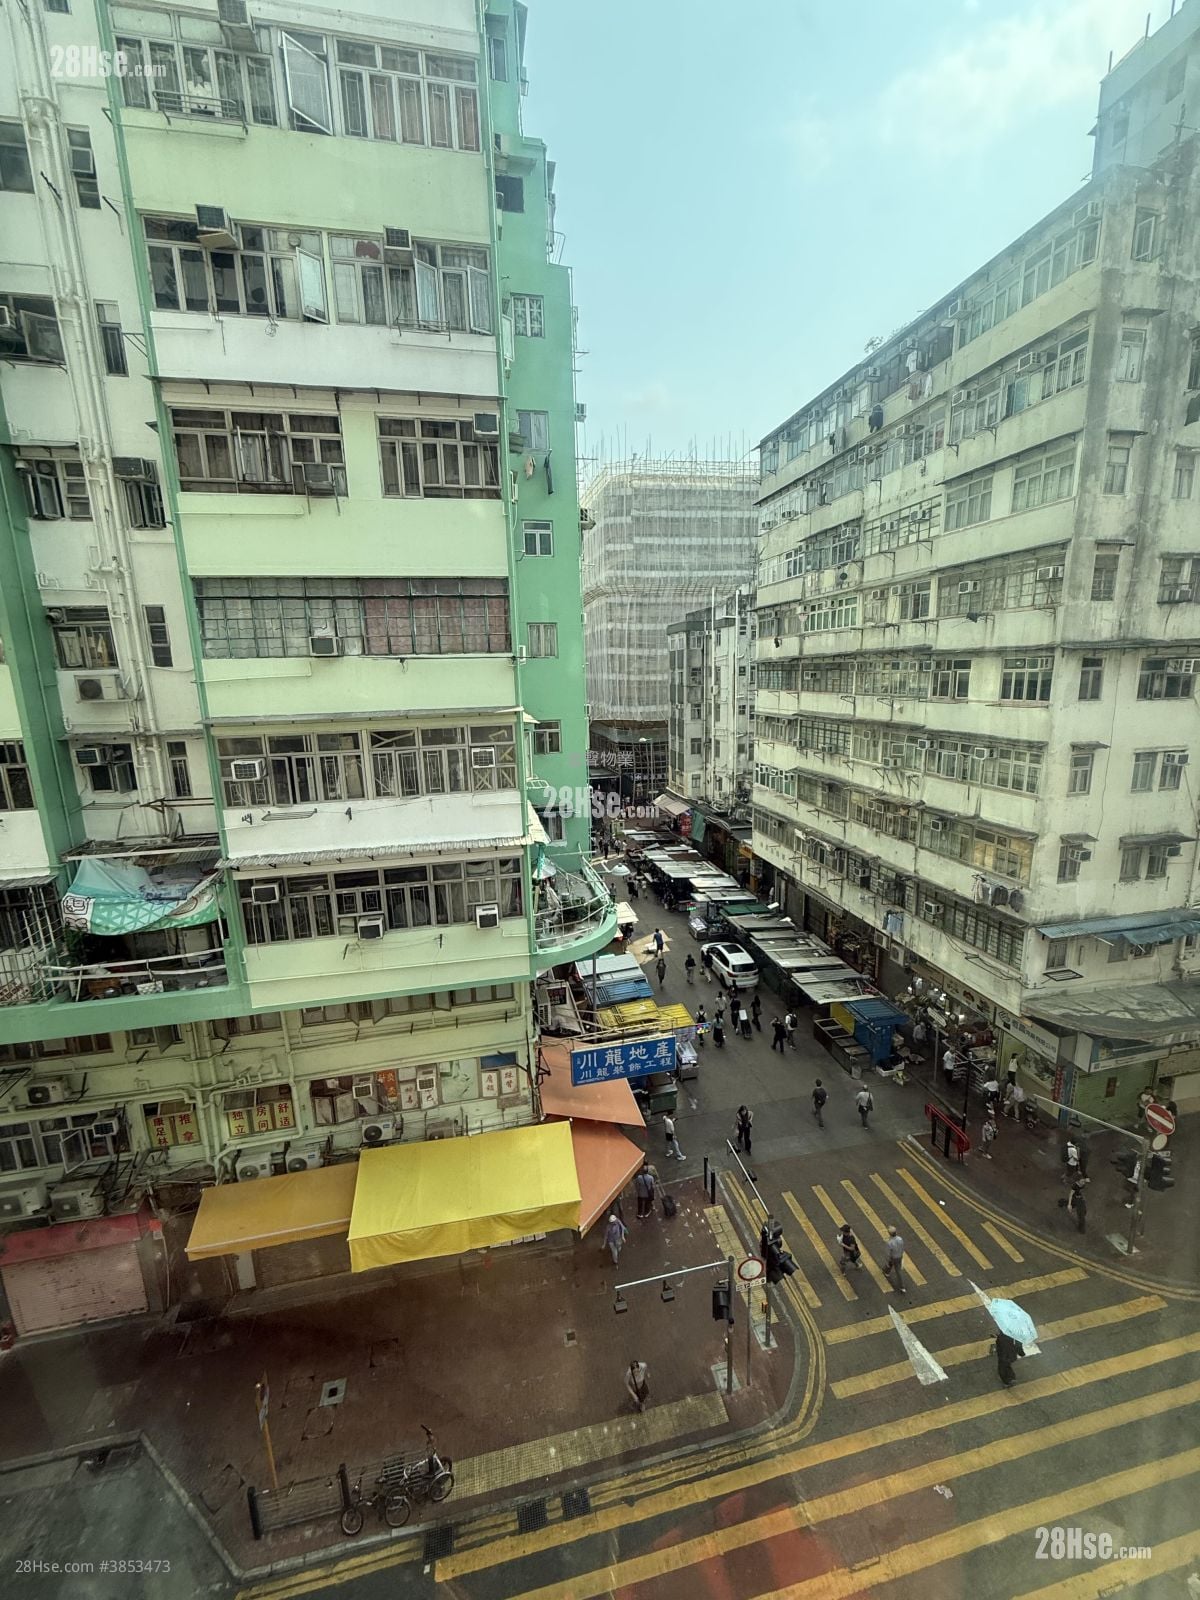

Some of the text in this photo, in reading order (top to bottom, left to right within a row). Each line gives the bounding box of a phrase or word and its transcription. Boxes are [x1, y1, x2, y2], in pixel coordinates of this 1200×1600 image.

[580, 1041, 673, 1069] 川龍地產
[580, 1058, 673, 1080] 川龍裝飾工程
